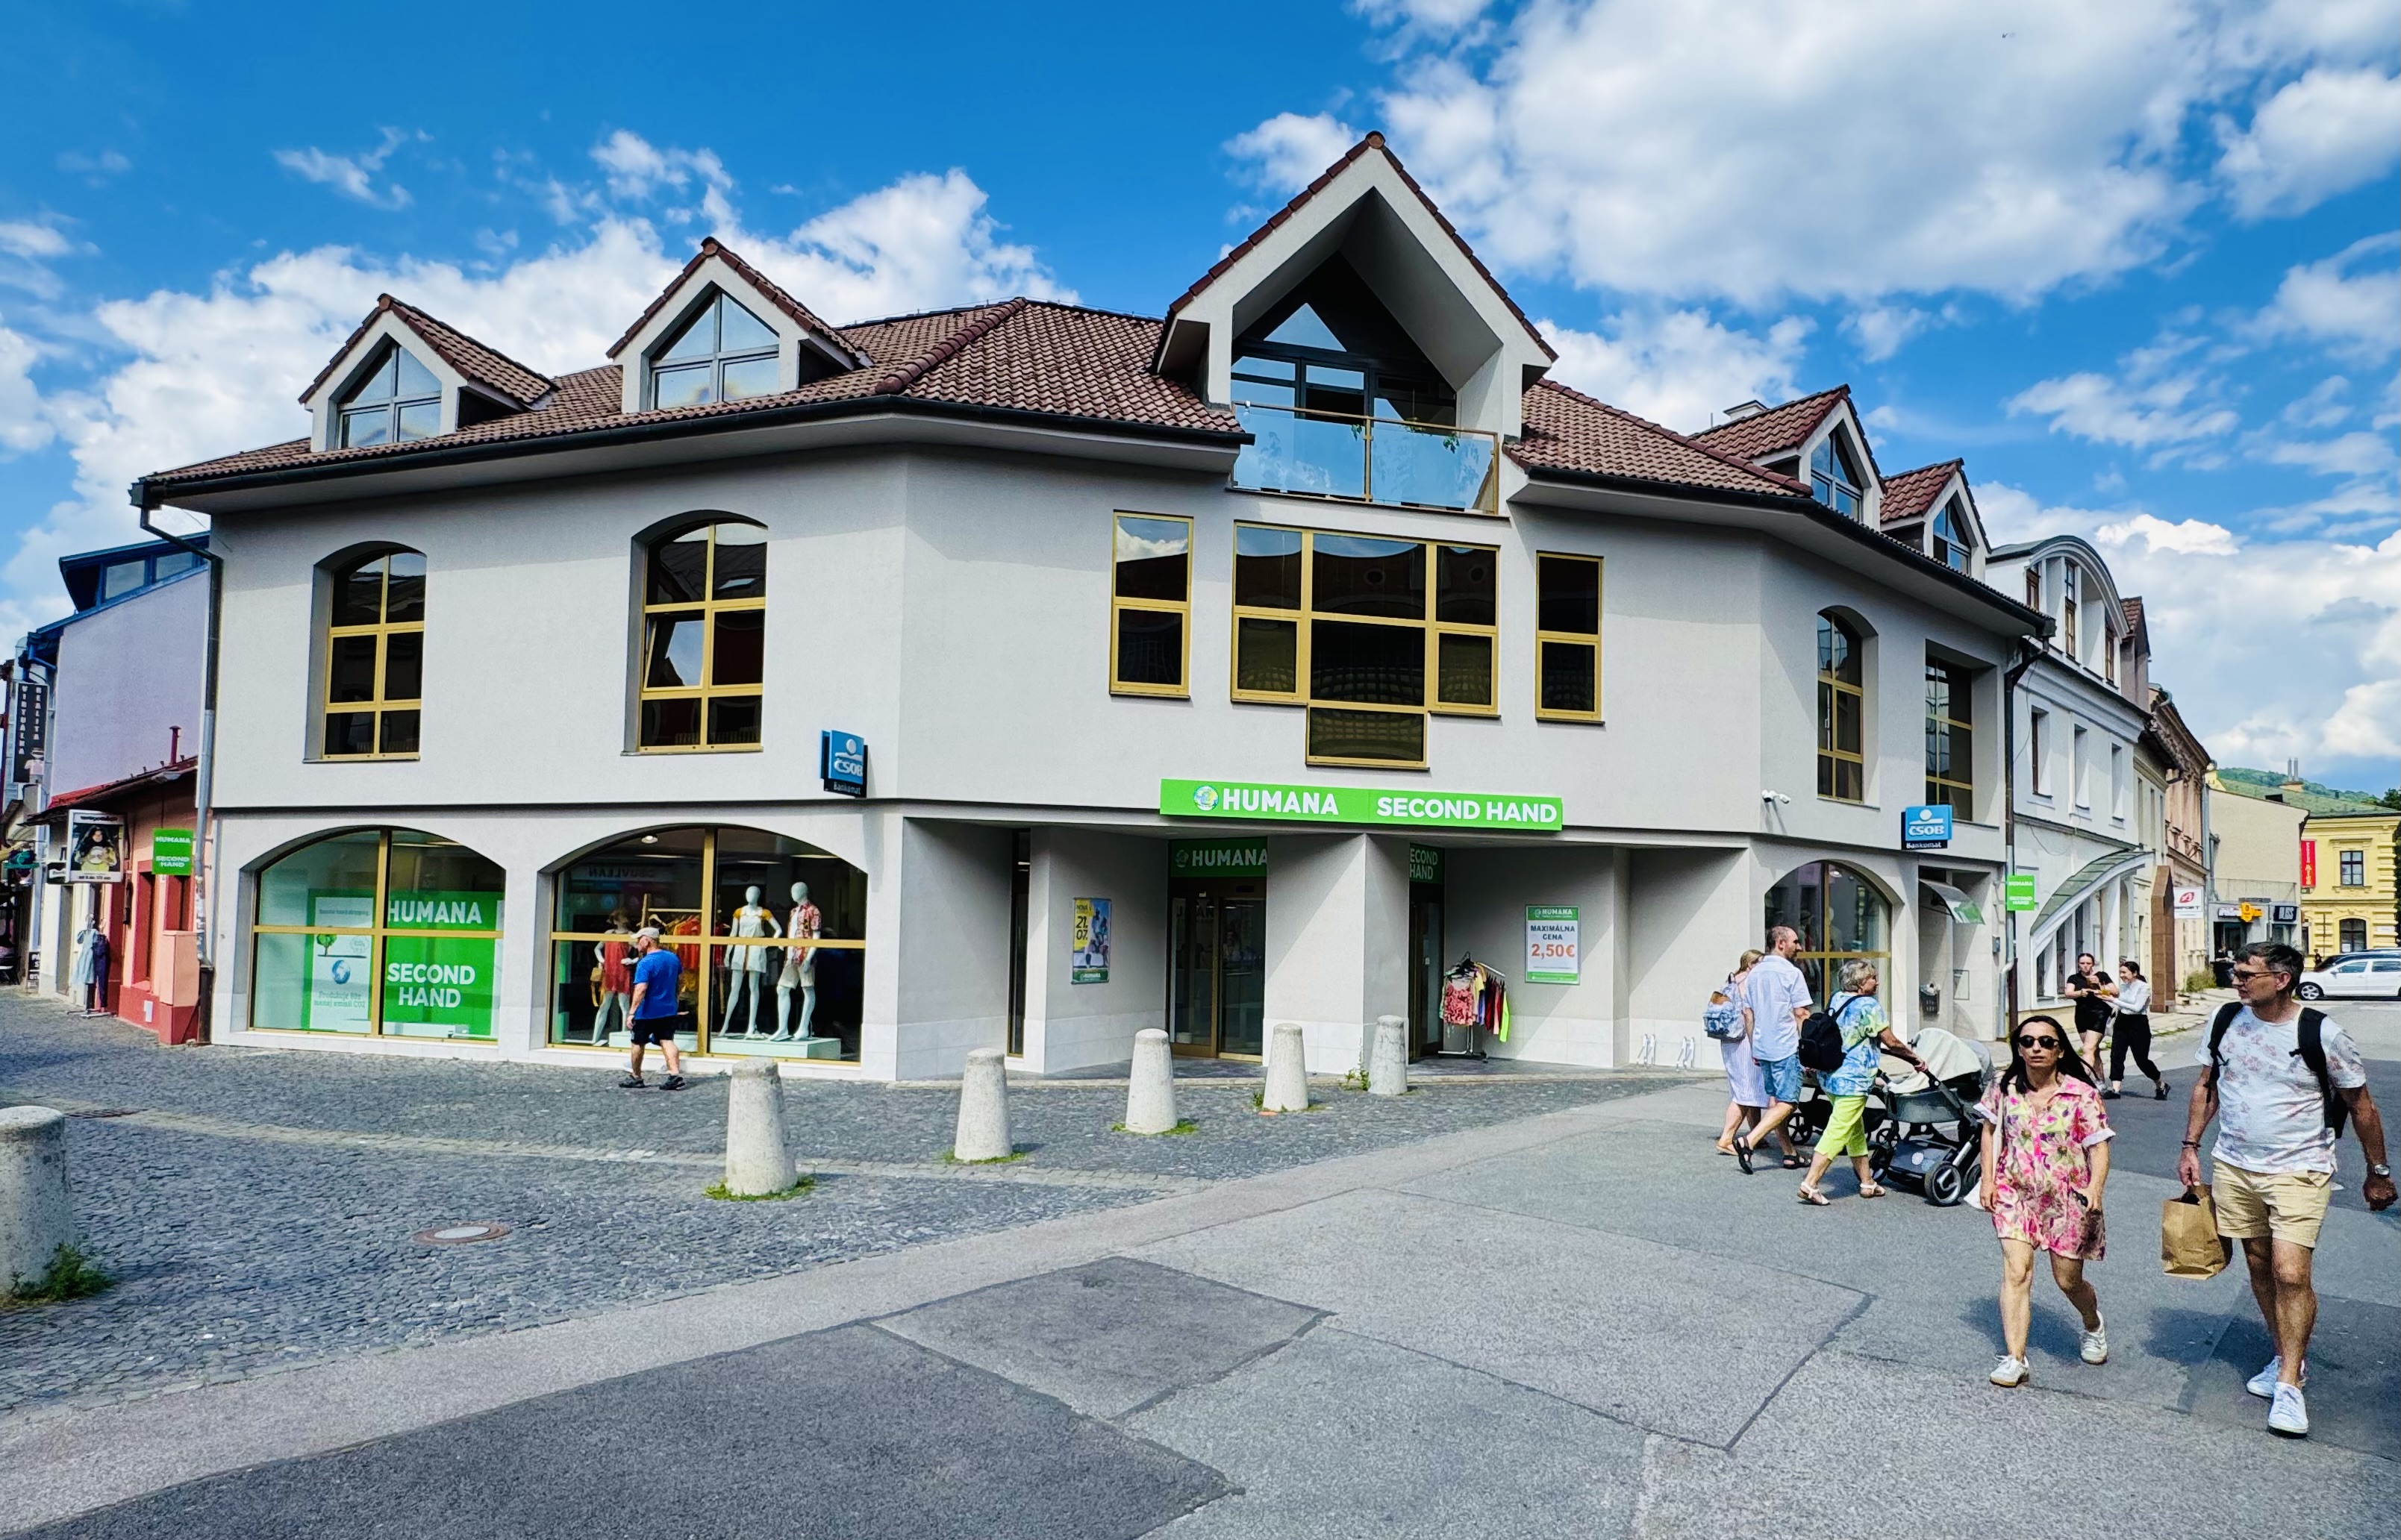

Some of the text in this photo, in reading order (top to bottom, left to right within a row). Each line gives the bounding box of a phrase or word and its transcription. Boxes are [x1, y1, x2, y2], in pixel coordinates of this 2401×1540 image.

[834, 757, 863, 777] ČSOB
[833, 781, 861, 795] Bankomat
[1223, 788, 1557, 823] HUMANA SECOND HAND
[1192, 848, 1267, 866] HUMANA
[1410, 863, 1434, 880] HAND
[387, 900, 482, 924] HUMANA
[1076, 929, 1088, 940] 07.
[1530, 924, 1576, 932] MAXIMÁLNA
[1532, 943, 1576, 960] 2,50€
[387, 962, 475, 985] SECOND
[398, 986, 461, 1008] HAND
